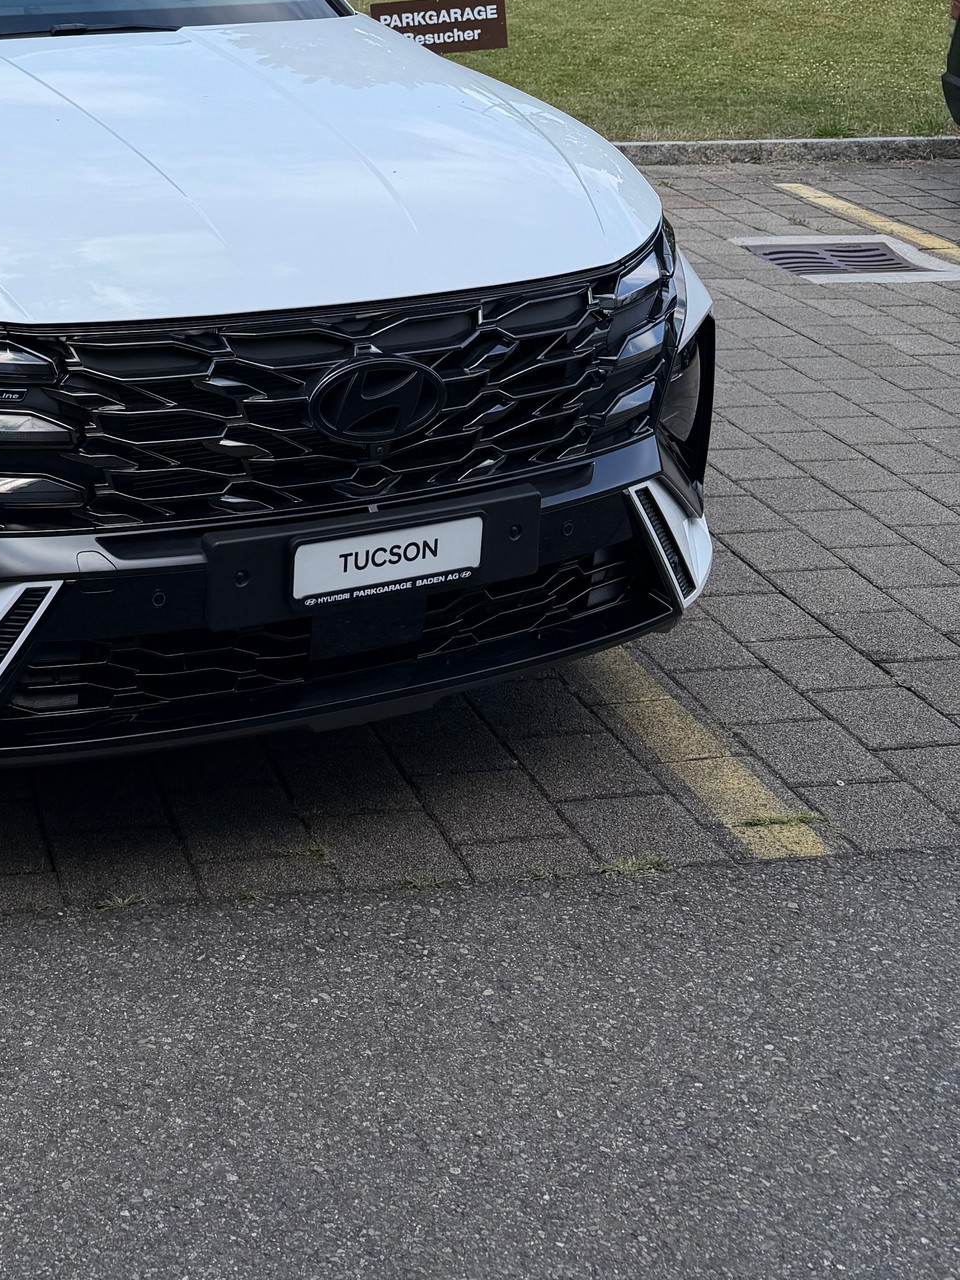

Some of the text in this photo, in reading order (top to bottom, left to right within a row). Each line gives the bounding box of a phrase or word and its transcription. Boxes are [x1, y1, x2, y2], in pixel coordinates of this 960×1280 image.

[380, 5, 498, 28] PARKGARAGE
[339, 538, 439, 573] TUCSON
[317, 572, 460, 604] HYUNDAI PARKGARAGE BADEN AG
